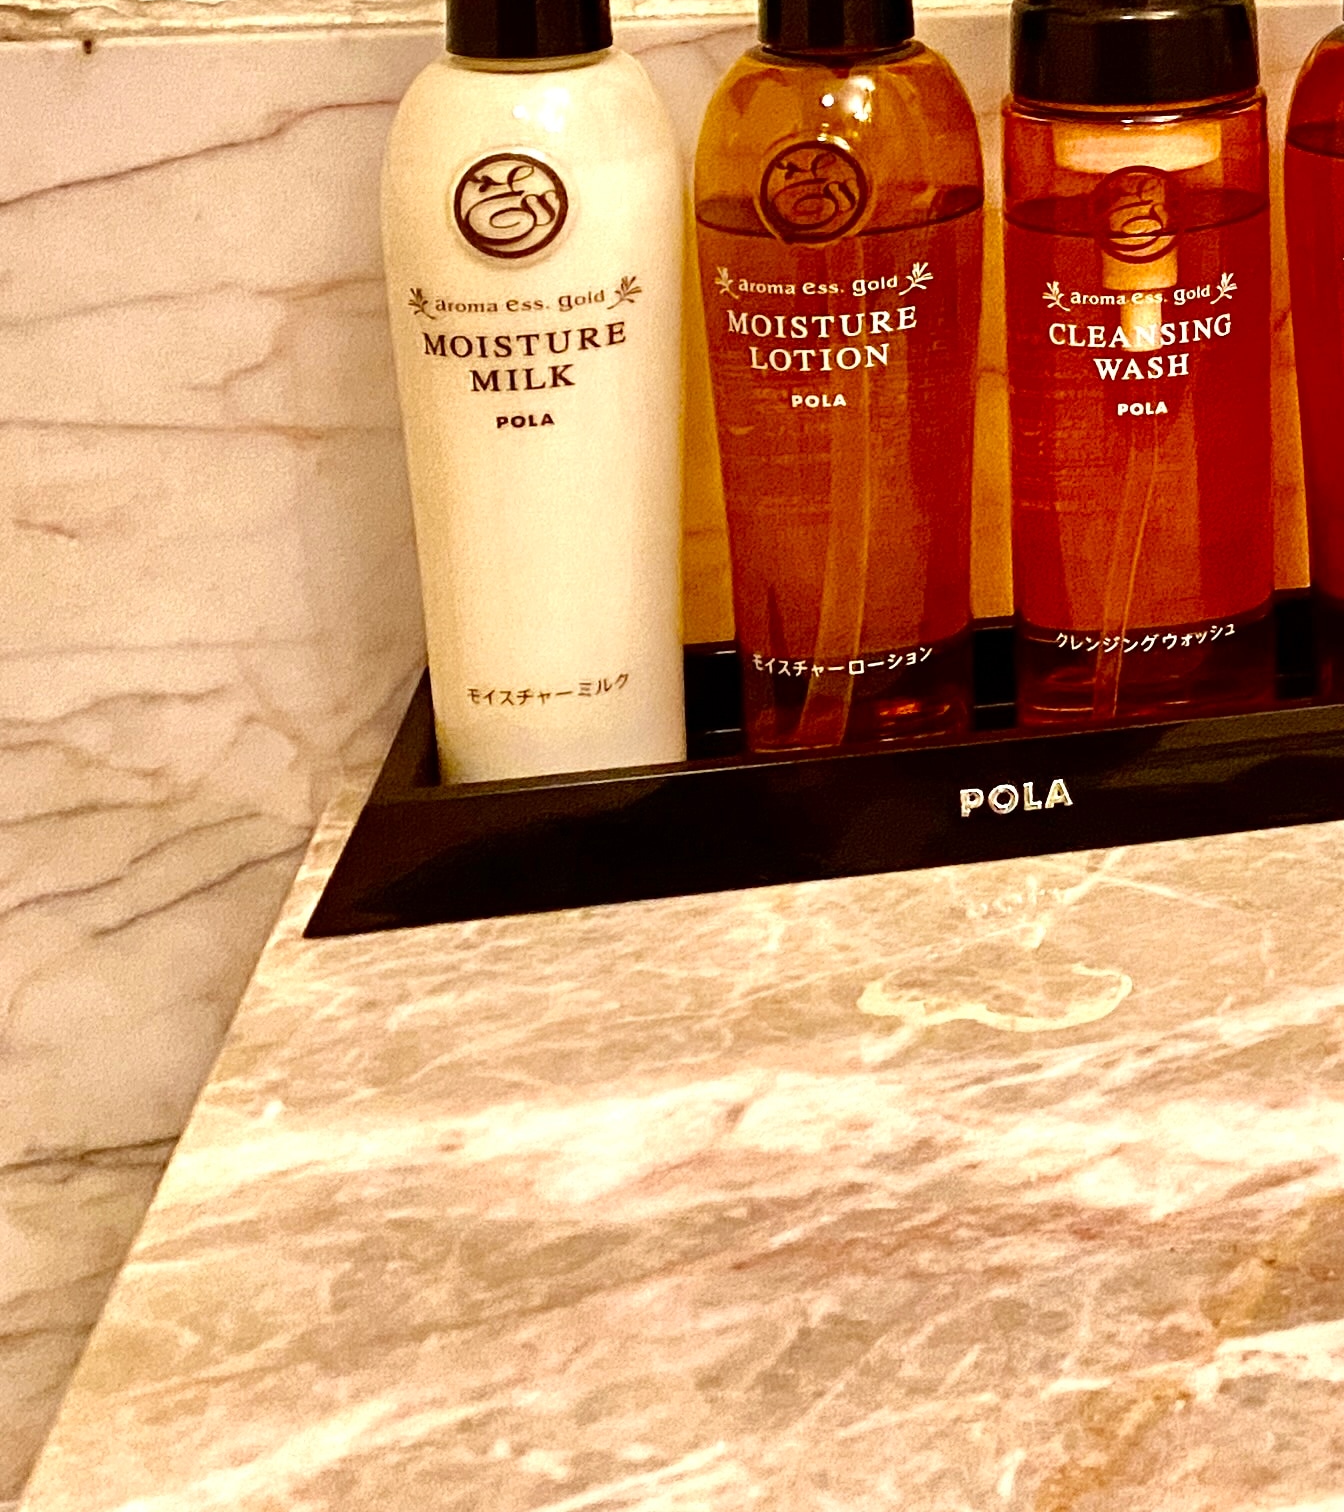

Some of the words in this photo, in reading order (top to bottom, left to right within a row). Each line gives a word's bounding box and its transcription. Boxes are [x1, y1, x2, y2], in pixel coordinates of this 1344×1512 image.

[737, 277, 796, 296] aroma
[802, 277, 845, 295] ess.
[852, 273, 898, 298] gold
[1070, 289, 1126, 306] aroma
[1130, 288, 1168, 306] ess.
[1173, 283, 1211, 307] gold
[434, 296, 498, 314] aroma
[505, 296, 551, 313] ess.
[558, 288, 606, 312] gold
[726, 305, 918, 340] MOISTURE
[1048, 313, 1232, 349] CLEANSING
[422, 320, 628, 359] MOISTURE
[749, 343, 890, 373] LOTION
[1093, 353, 1190, 382] WASH
[469, 364, 576, 392] MILK
[791, 392, 847, 409] POLA
[1117, 401, 1168, 417] POLA
[496, 412, 555, 429] POLA
[1056, 623, 1236, 654] クレンジングウォッシュ
[752, 647, 933, 678] モイスチャーローション
[467, 672, 629, 706] モイスチャーミルク
[959, 778, 1074, 818] POLA
